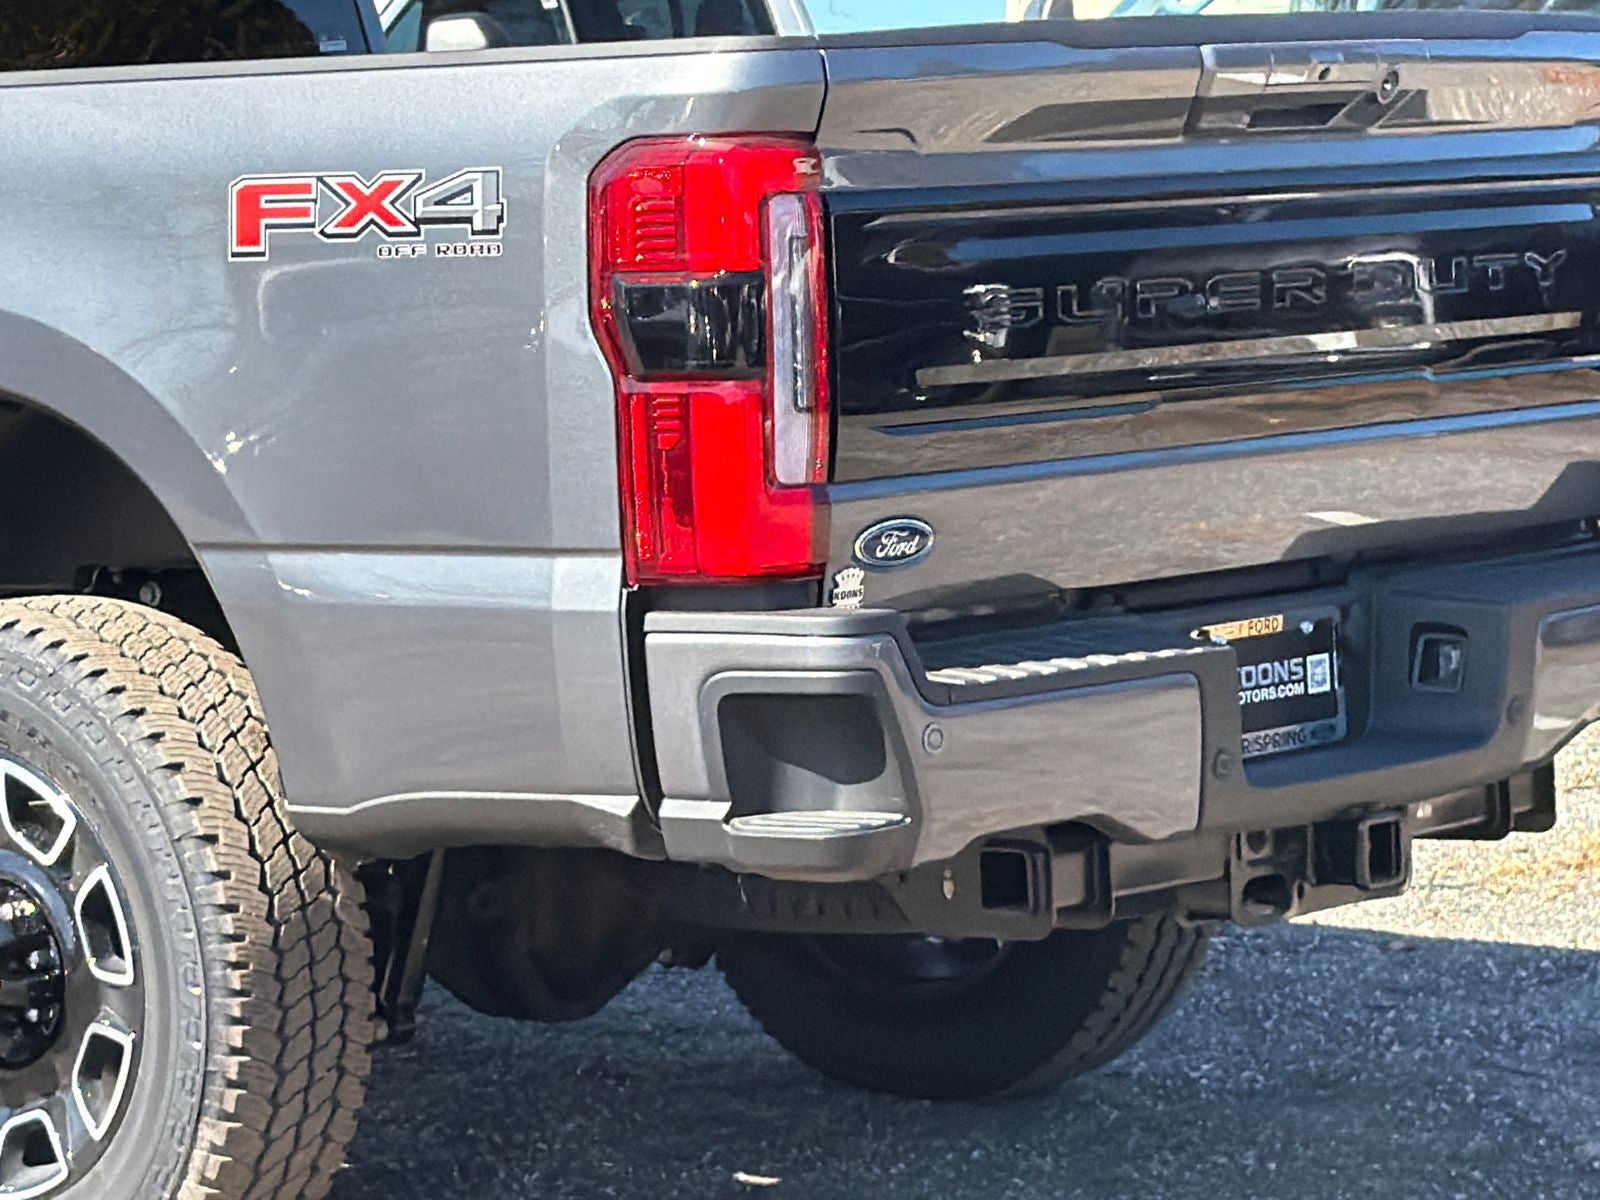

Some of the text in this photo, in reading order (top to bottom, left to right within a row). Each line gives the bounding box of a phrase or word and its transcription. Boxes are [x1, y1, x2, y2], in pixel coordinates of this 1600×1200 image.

[229, 167, 507, 261] FX4
[377, 242, 502, 259] OFF ROAD
[970, 268, 1327, 328] SUPER
[875, 531, 920, 558] Ford
[1247, 617, 1280, 636] FORD
[1238, 657, 1304, 689] OONS
